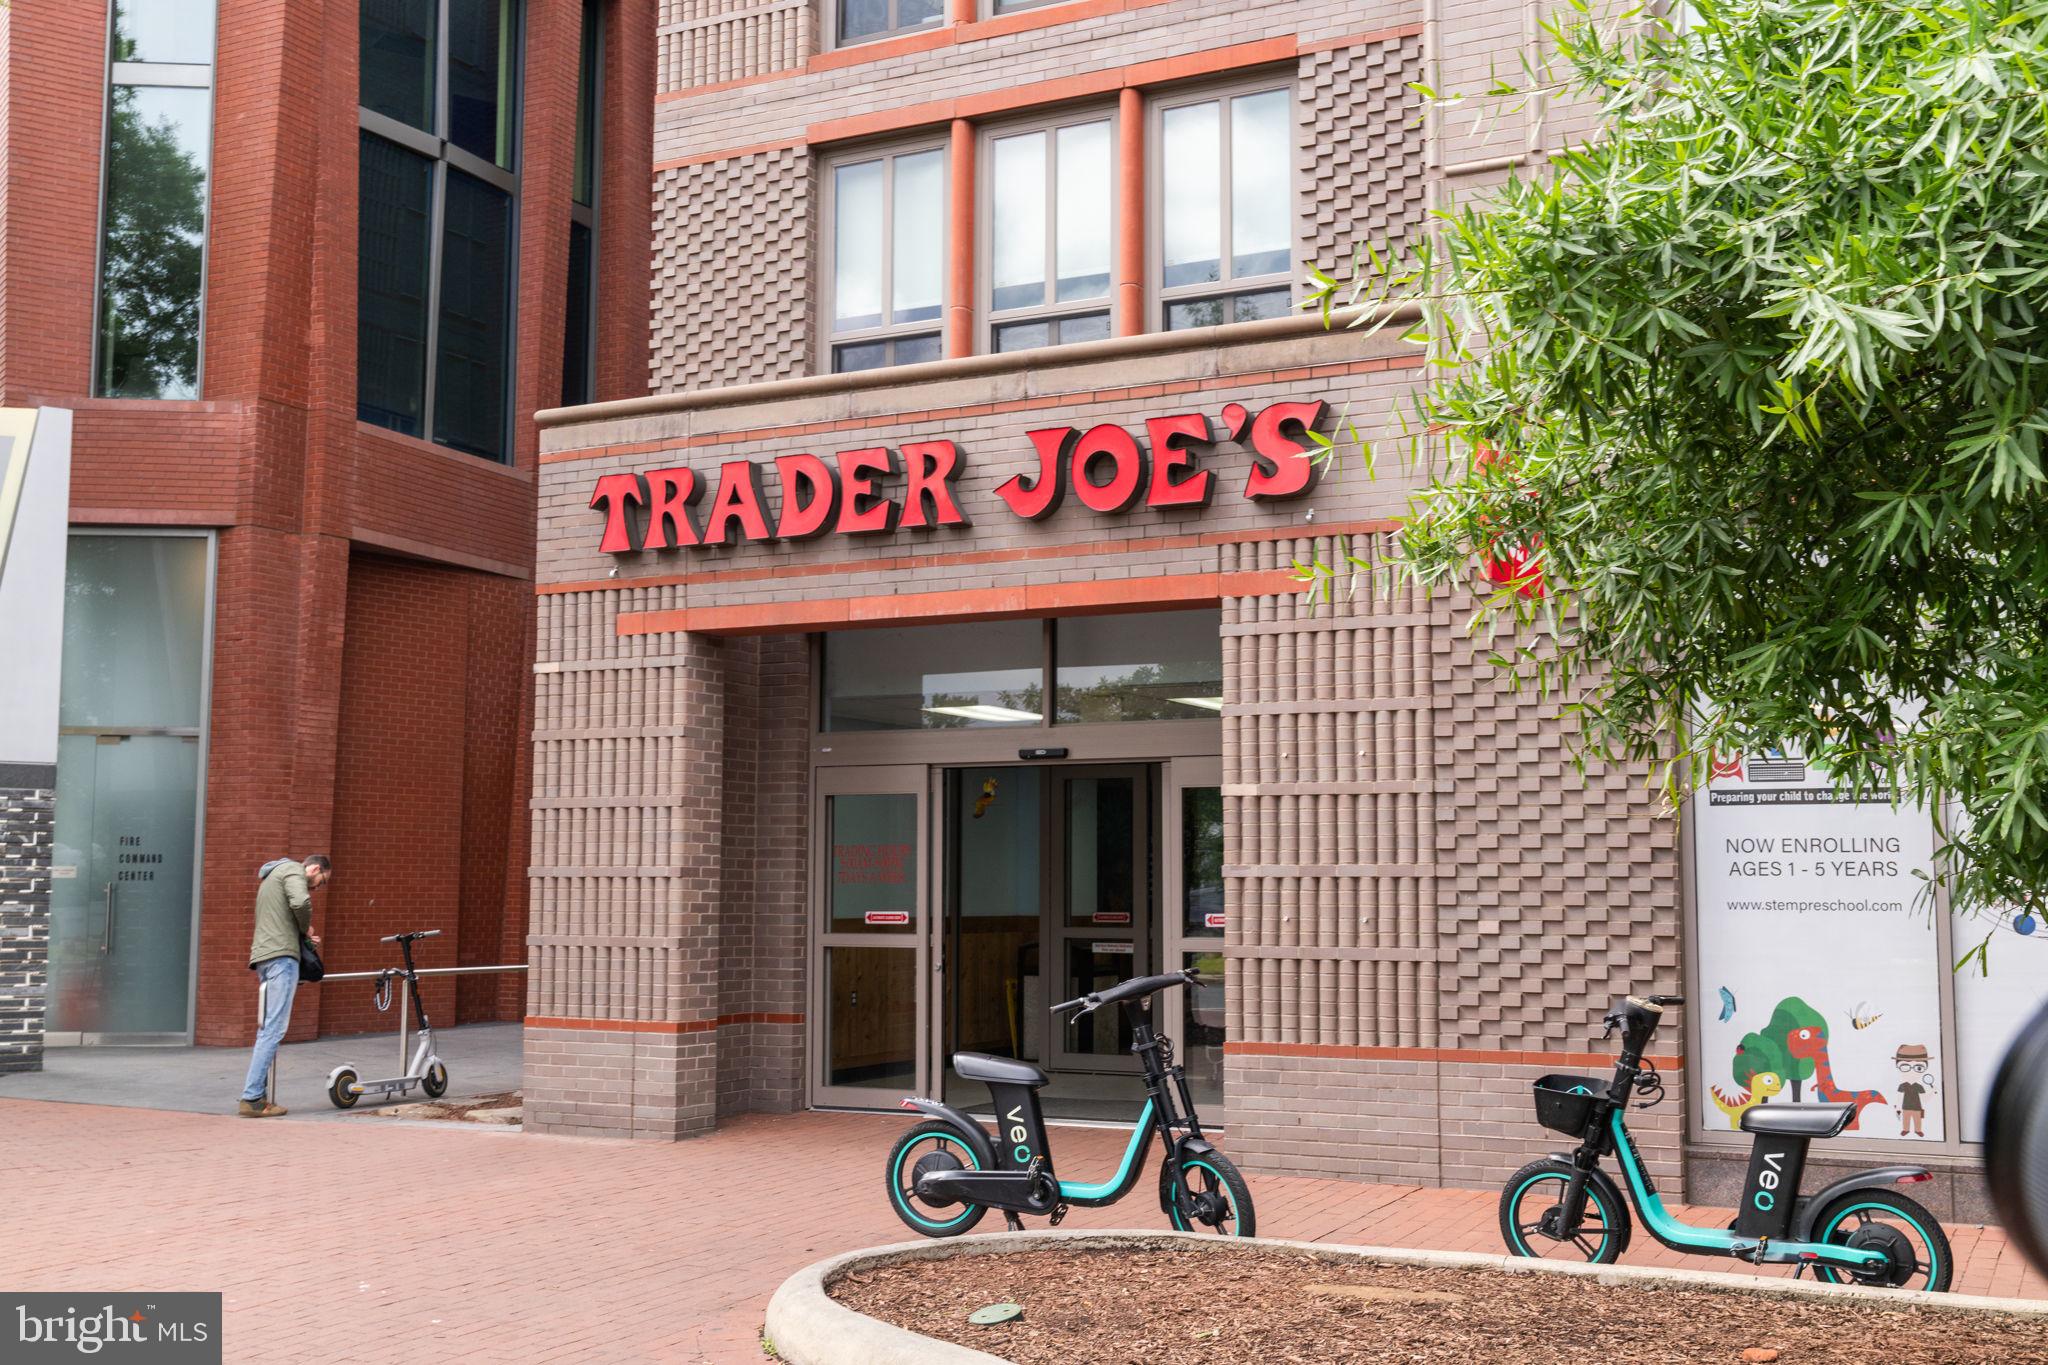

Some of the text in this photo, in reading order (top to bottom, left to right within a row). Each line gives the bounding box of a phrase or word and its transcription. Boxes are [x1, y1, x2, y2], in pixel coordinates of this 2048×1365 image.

[588, 399, 1331, 555] TRADER JOE'S
[1710, 792, 1755, 804] Preparing
[1756, 793, 1777, 804] your
[1778, 790, 1802, 802] child
[1803, 790, 1815, 801] to
[1816, 790, 1851, 803] chage
[120, 836, 141, 846] FIRE
[1726, 837, 1901, 853] NOW ENROLLING
[119, 853, 163, 864] COMMAND
[118, 871, 155, 881] CENTER
[1729, 861, 1783, 877] AGES
[1788, 862, 1795, 876] 1
[1815, 862, 1826, 877] 5
[1831, 861, 1899, 877] YEARS
[1727, 899, 1903, 914] www.stempreschool.com
[1006, 1104, 1031, 1163] veo
[1754, 1152, 1785, 1211] veo
